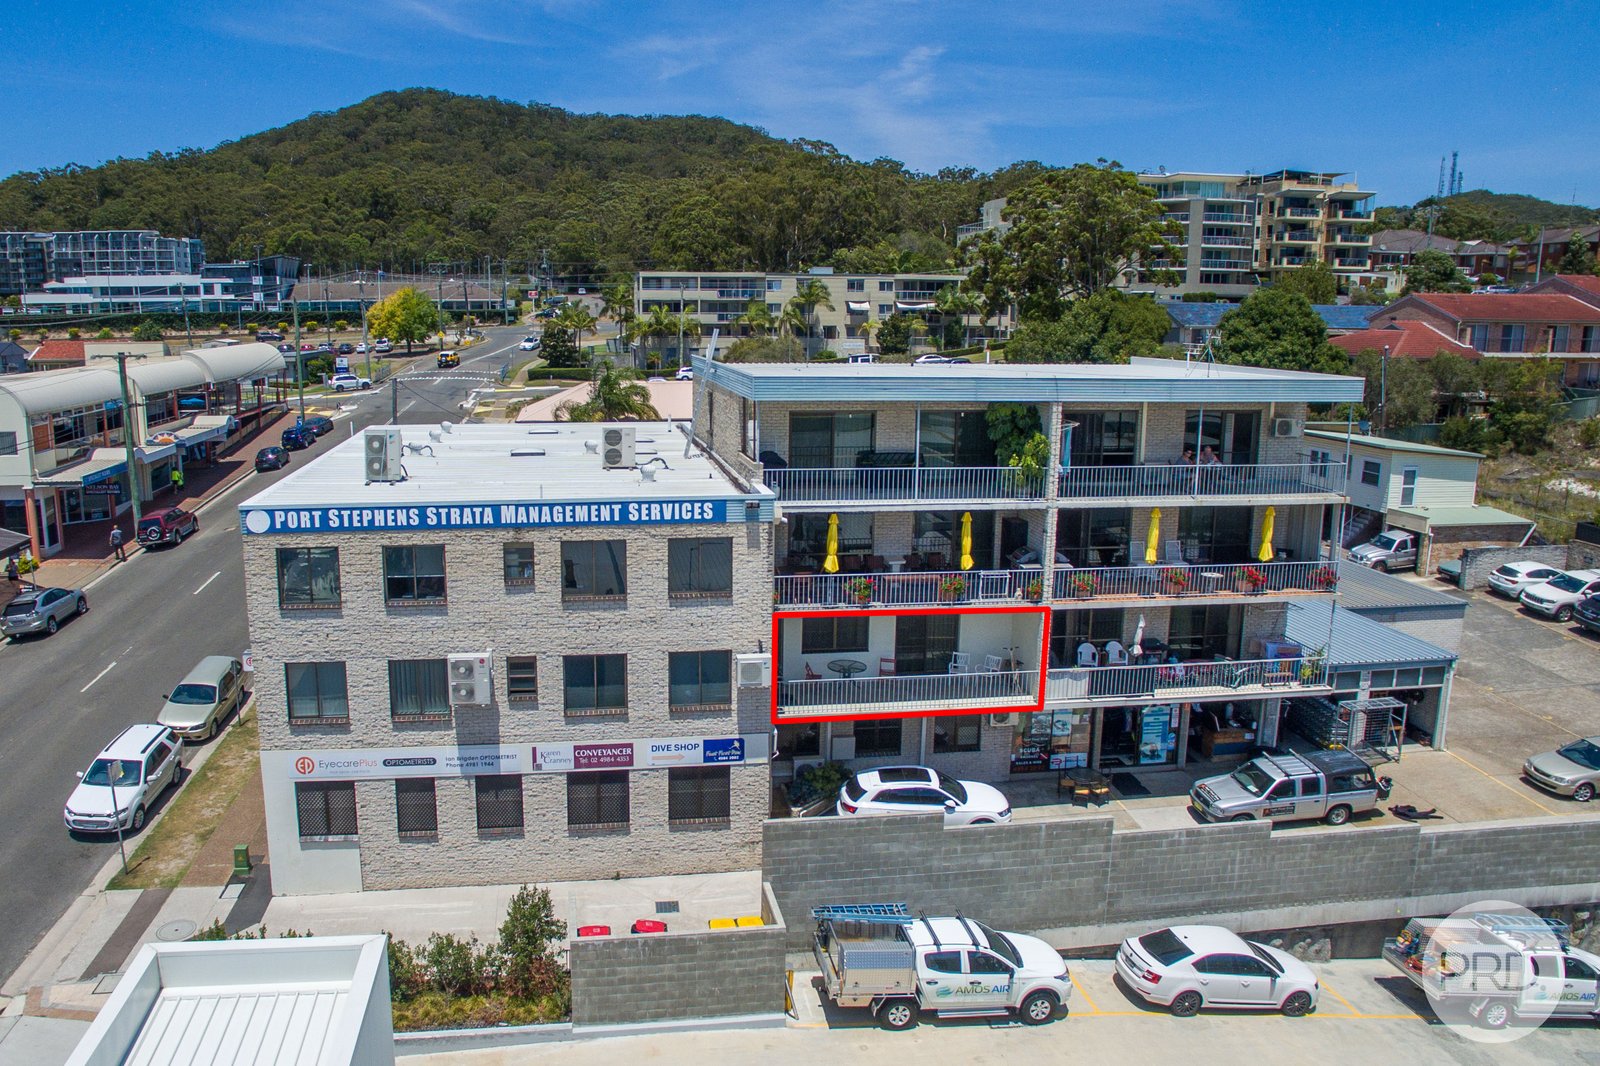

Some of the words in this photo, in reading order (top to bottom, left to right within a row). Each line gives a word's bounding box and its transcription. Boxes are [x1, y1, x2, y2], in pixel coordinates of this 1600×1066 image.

[274, 510, 322, 529] PORT
[328, 508, 420, 528] STEPHENS
[426, 506, 494, 525] STRATA
[500, 503, 622, 524] MANAGEMENT
[628, 502, 714, 521] SERVICES
[575, 747, 632, 757] CONVEYANCER
[651, 744, 672, 752] DIVE
[674, 743, 700, 751] SHOP
[540, 750, 561, 759] Karen
[318, 758, 378, 770] EyecarePlus
[385, 758, 434, 766] OPTOMETRISTS
[543, 756, 573, 764] Cranney
[955, 985, 991, 994] AMOS
[991, 984, 1010, 993] AIR
[1551, 992, 1579, 1001] AMOS
[1579, 992, 1597, 1001] AIR
